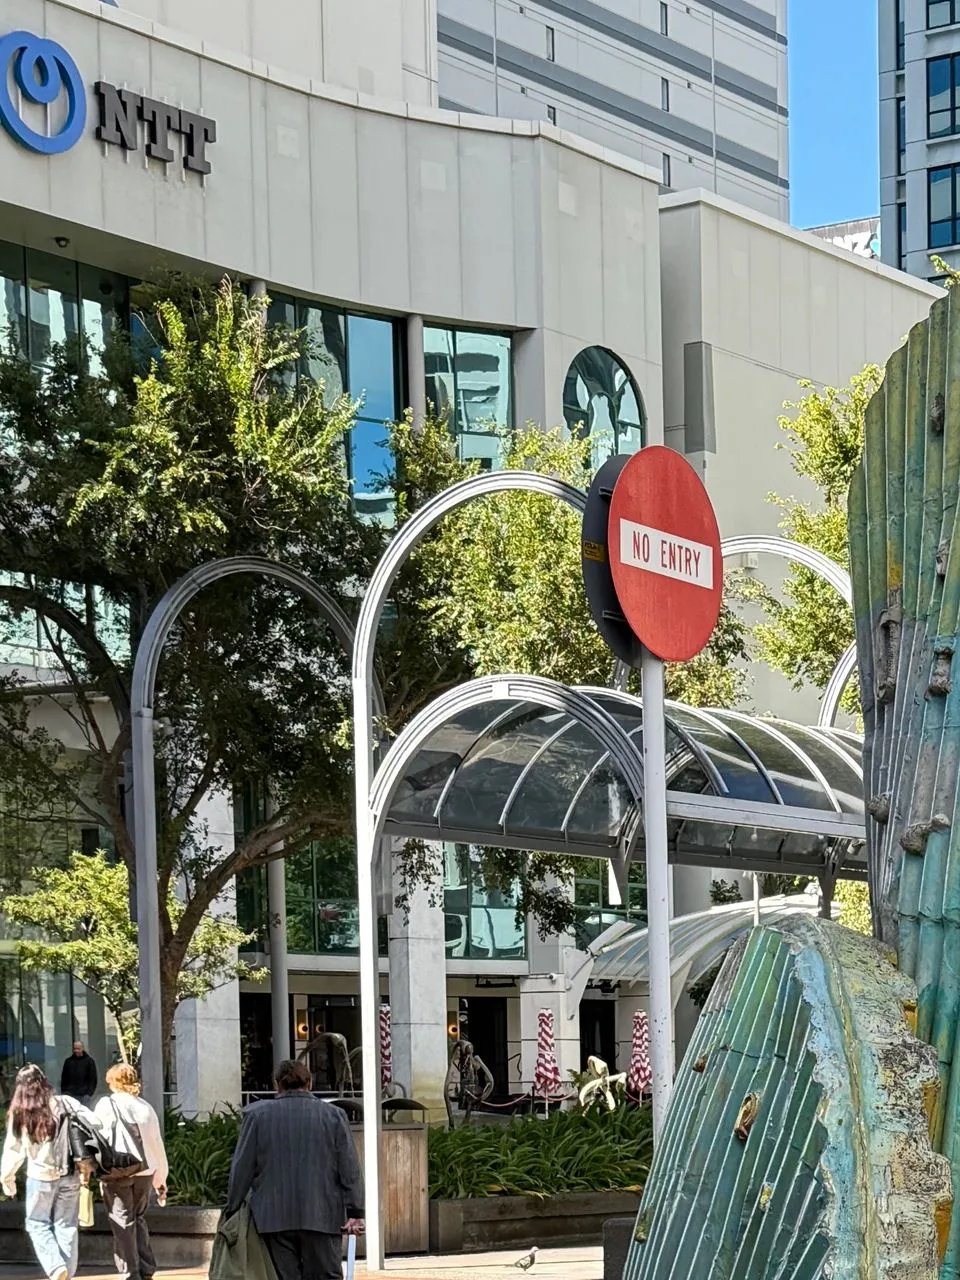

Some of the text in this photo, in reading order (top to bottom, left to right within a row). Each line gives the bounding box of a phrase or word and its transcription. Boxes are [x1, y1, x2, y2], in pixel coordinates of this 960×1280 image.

[94, 80, 217, 175] NTT
[633, 530, 650, 563] NO
[661, 540, 701, 578] ENTRY
